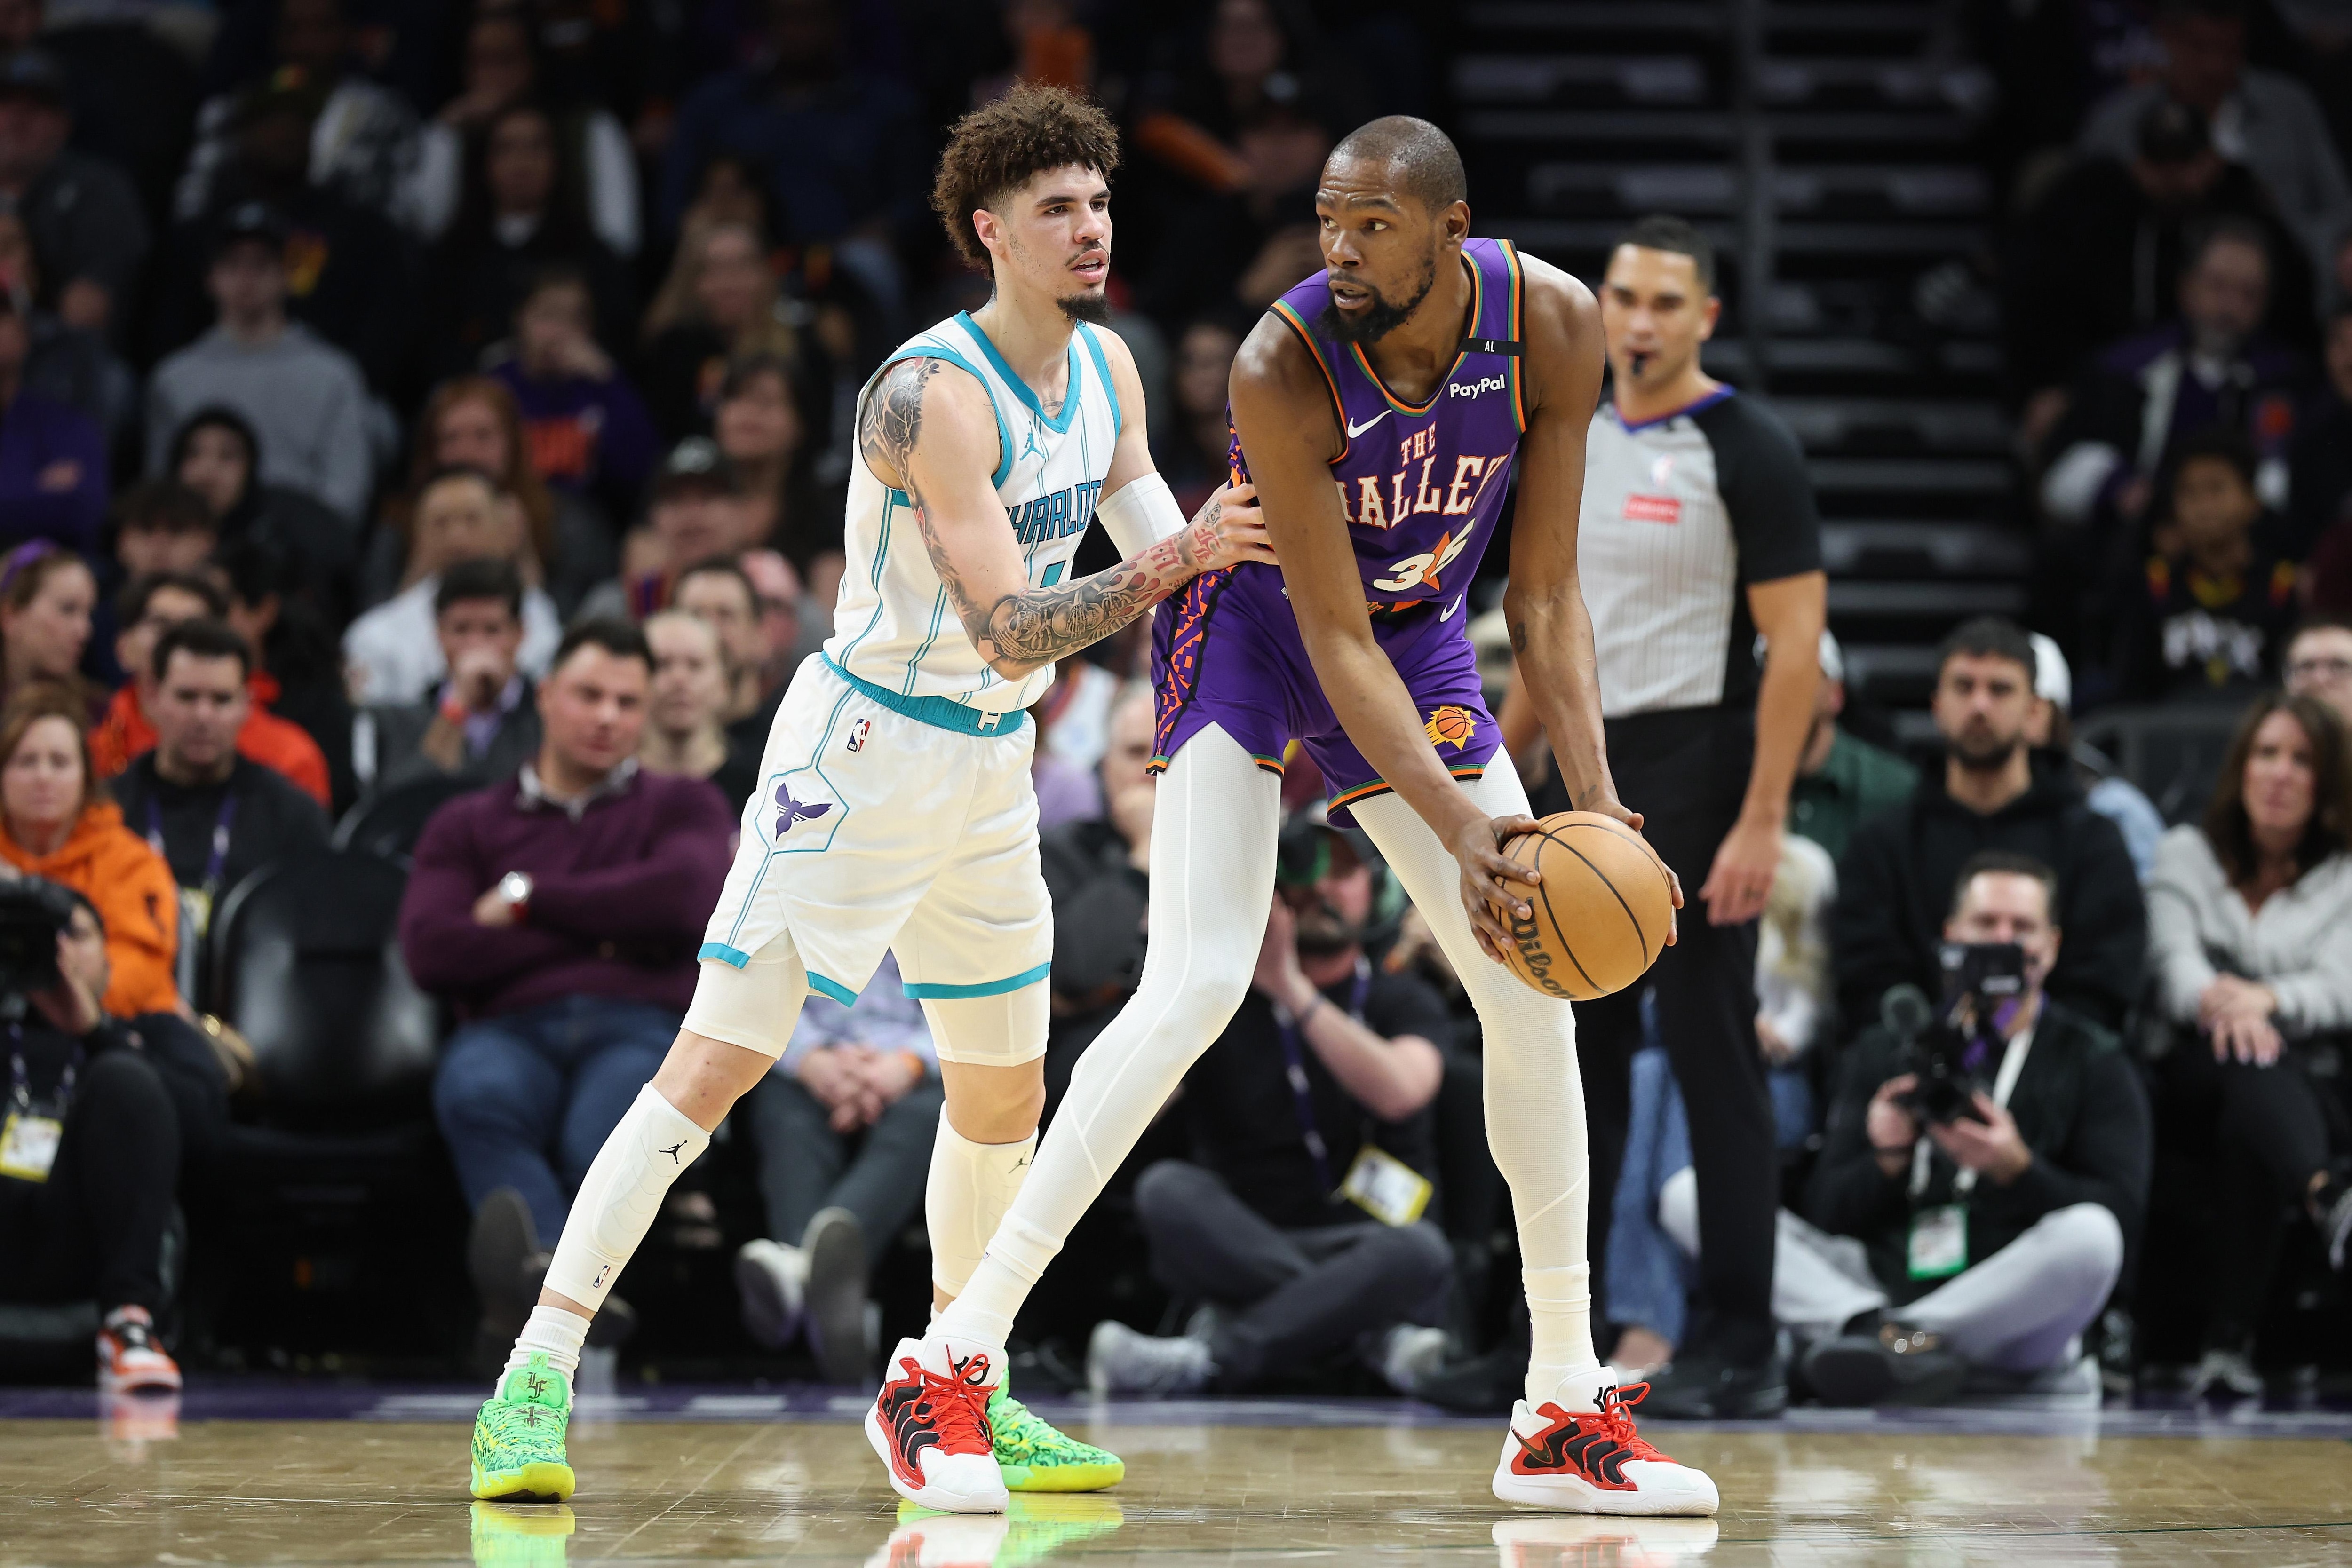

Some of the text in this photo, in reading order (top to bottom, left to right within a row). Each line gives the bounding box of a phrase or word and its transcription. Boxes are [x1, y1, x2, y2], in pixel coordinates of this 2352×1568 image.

[1484, 341, 1495, 352] AL
[1450, 374, 1505, 399] PayPal
[1400, 421, 1436, 467] THE
